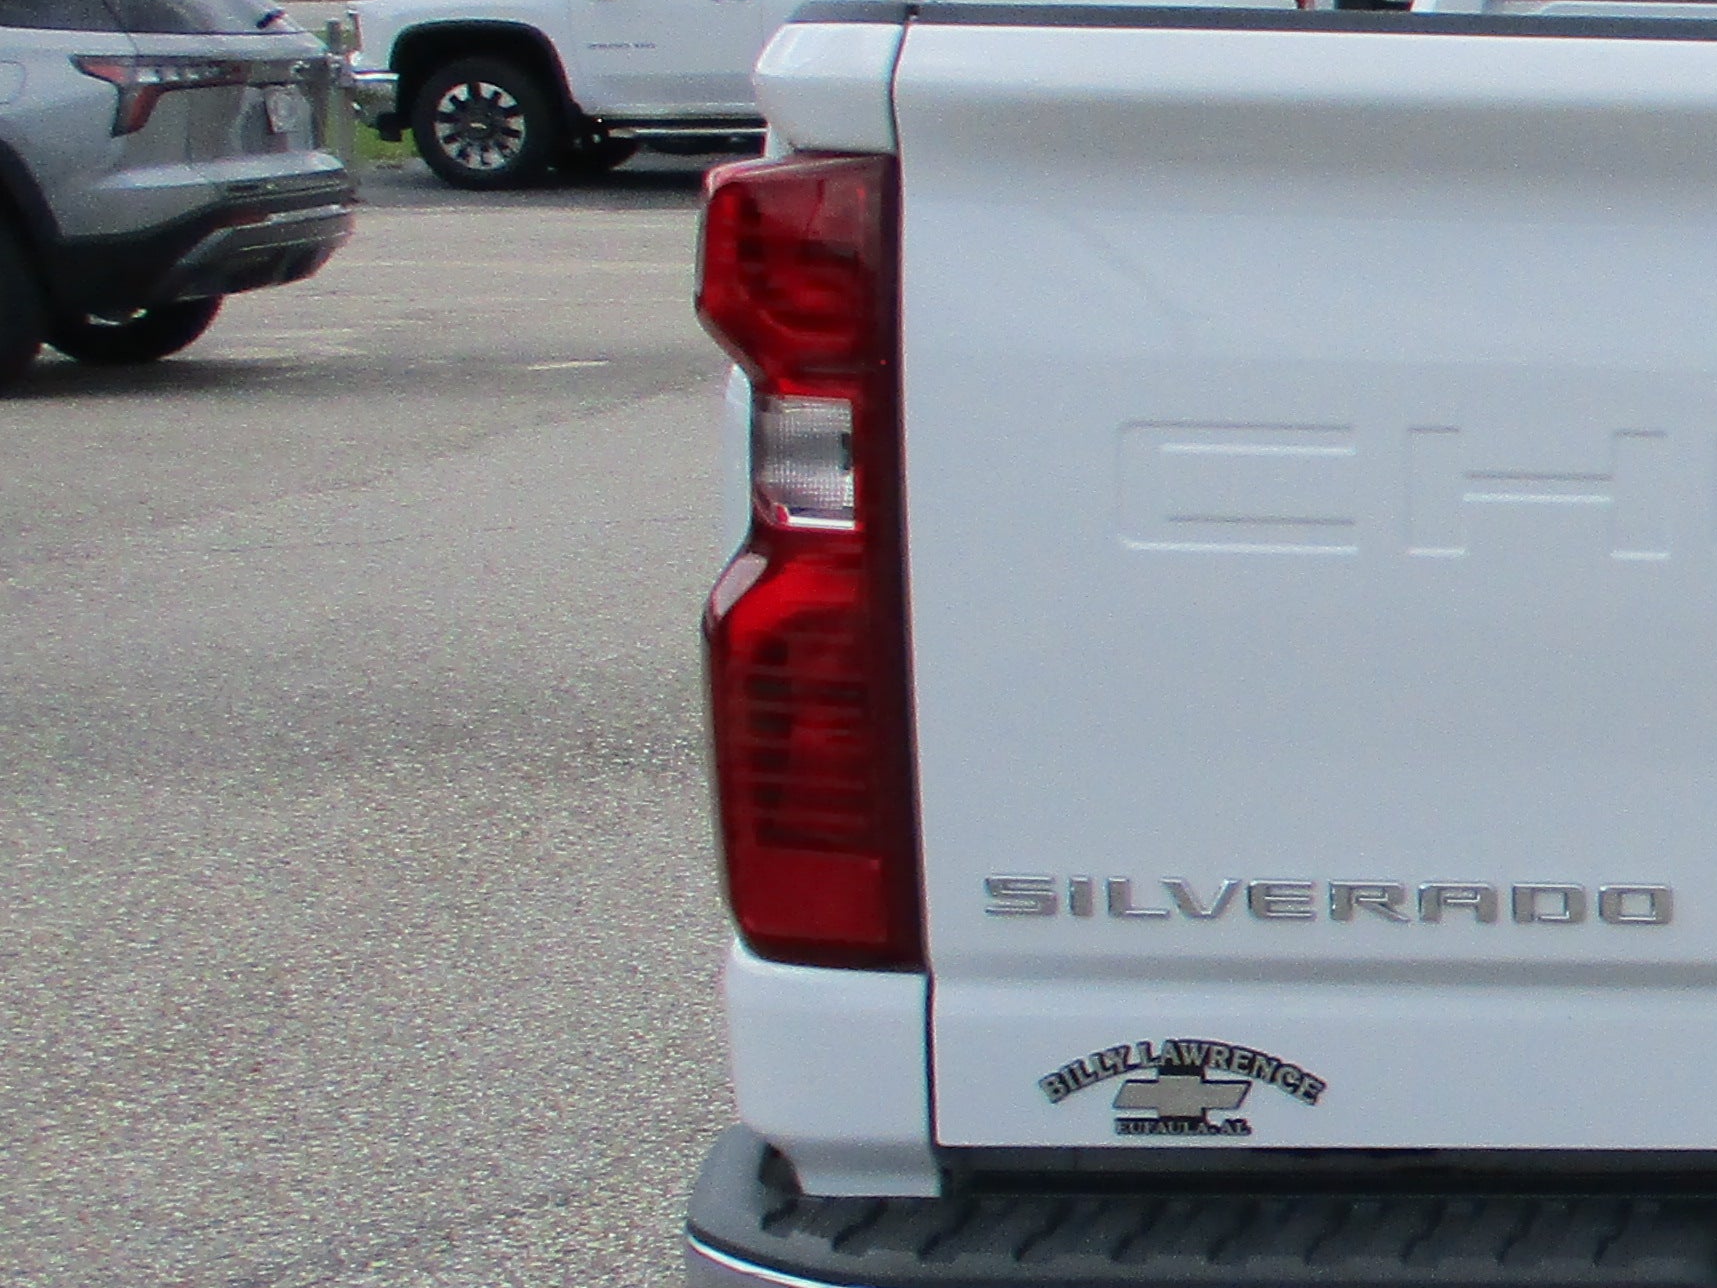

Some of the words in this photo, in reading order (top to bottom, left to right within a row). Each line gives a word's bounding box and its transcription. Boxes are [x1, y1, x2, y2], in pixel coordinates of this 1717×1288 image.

[984, 873, 1675, 926] SILVERADO
[1039, 1044, 1132, 1104] BILLY
[1135, 1039, 1327, 1106] LAWRENCE
